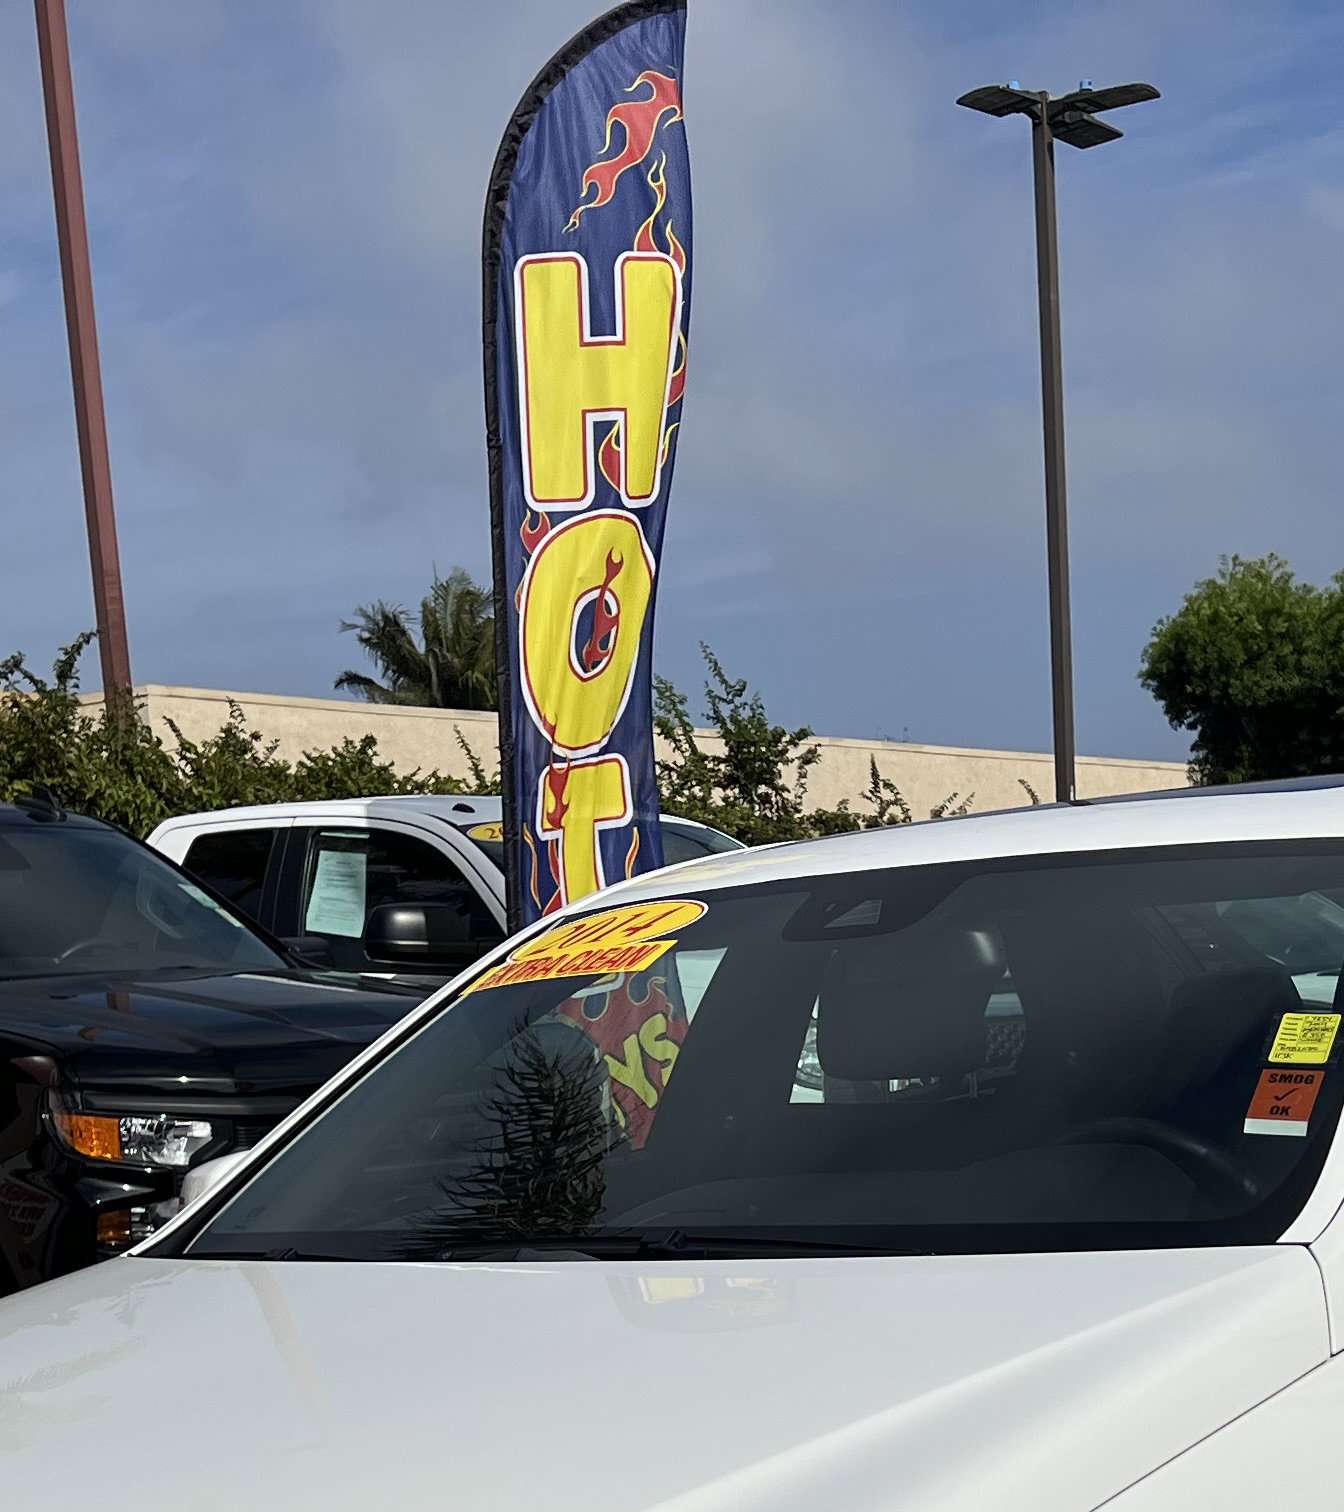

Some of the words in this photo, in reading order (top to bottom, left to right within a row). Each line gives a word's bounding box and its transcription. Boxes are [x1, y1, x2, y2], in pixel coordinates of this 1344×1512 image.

[513, 250, 685, 908] HOT
[528, 905, 686, 956] 2014
[556, 943, 662, 976] CLEAN
[1267, 1072, 1316, 1085] SMOG
[1269, 1104, 1292, 1117] OK
